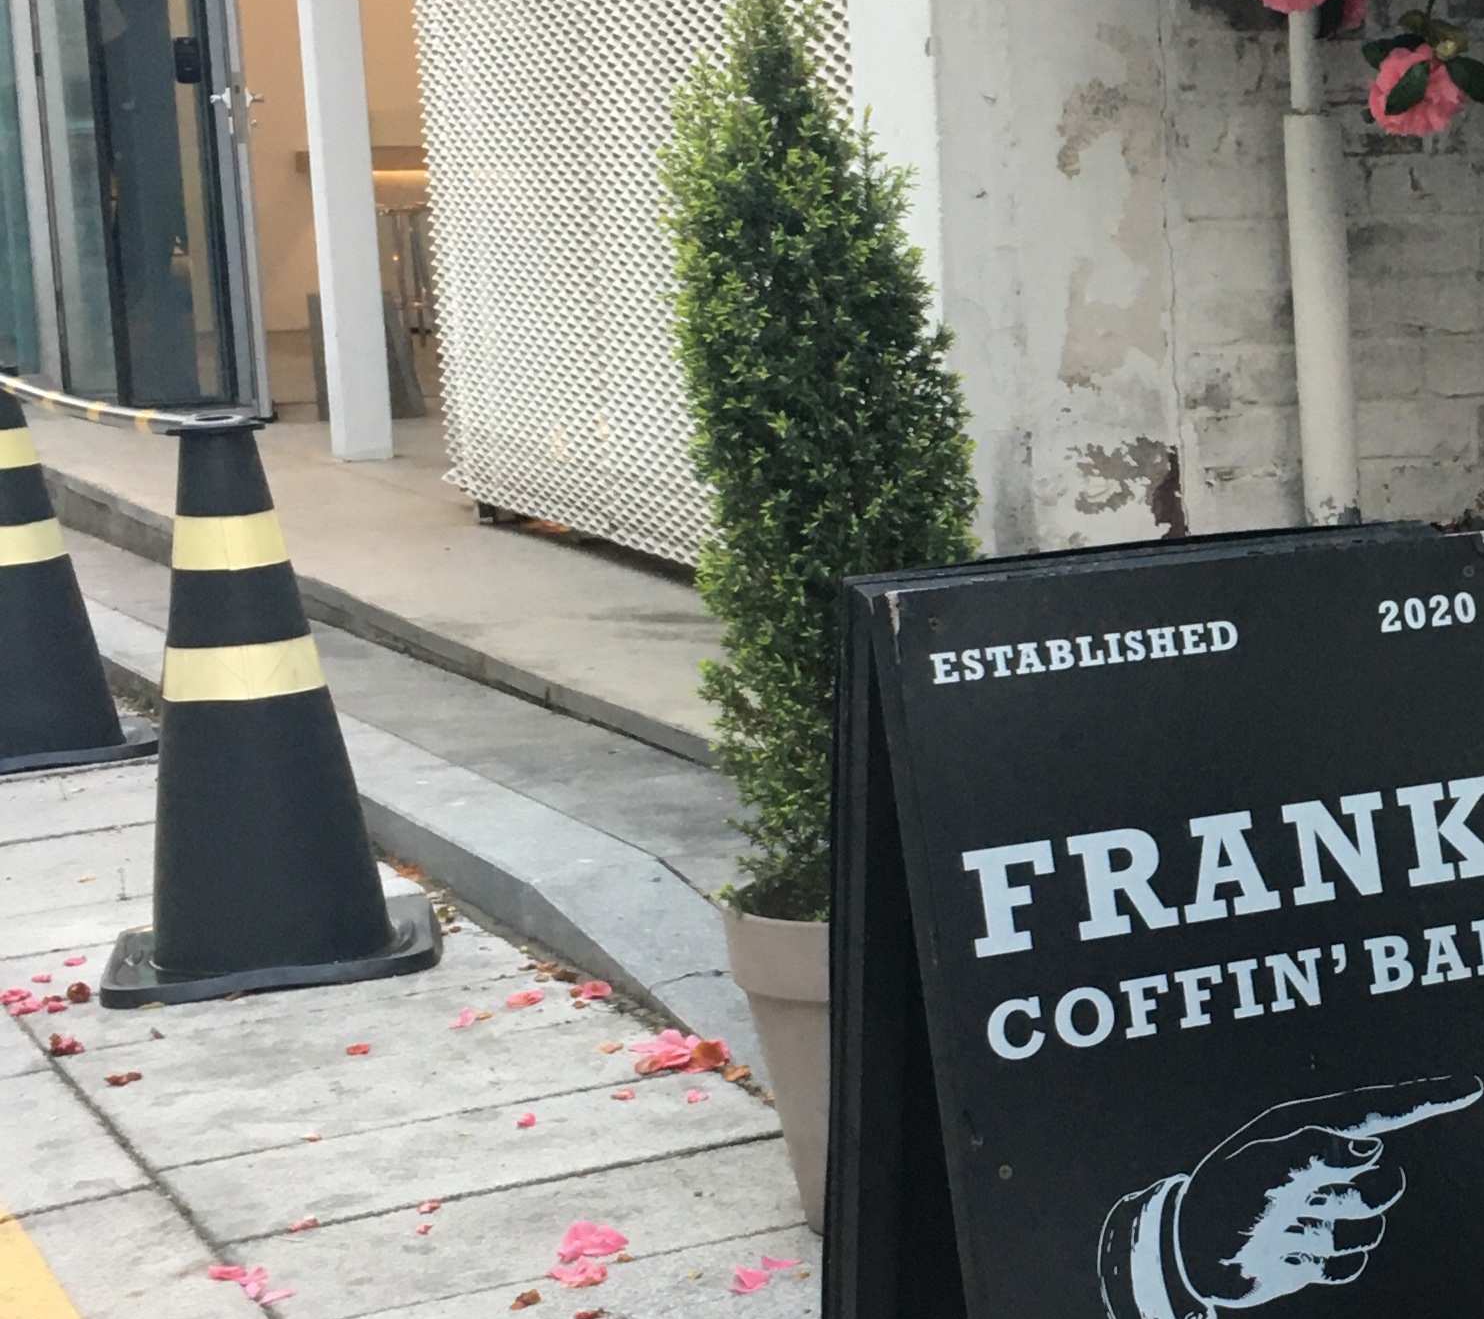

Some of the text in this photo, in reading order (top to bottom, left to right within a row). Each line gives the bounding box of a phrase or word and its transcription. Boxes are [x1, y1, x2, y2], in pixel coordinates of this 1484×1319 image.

[929, 591, 1477, 686] ESTABLISHED 2020
[987, 942, 1348, 1061] COFFIN'
